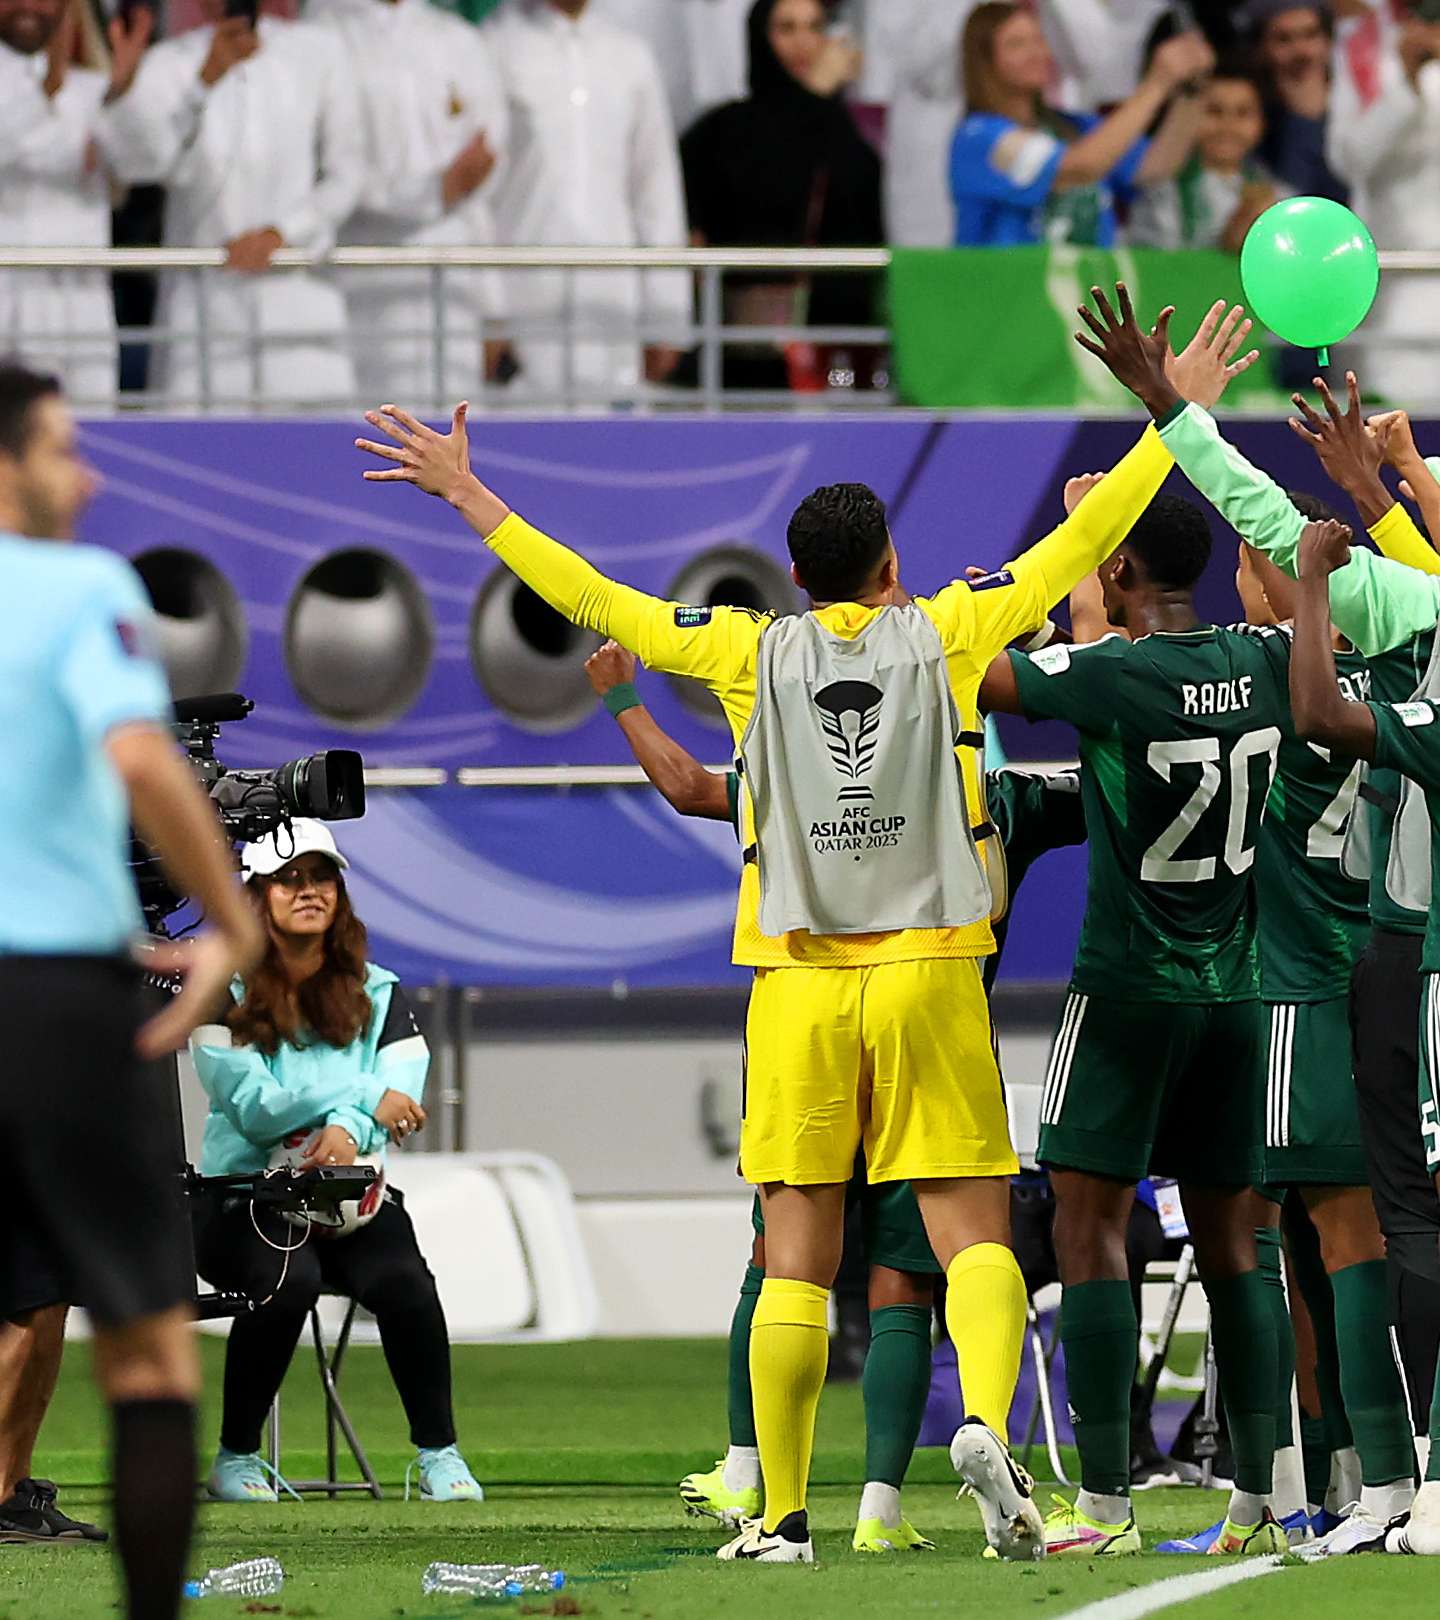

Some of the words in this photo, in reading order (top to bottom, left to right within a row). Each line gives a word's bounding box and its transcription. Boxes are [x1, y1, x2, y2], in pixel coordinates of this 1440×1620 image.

[1182, 675, 1252, 715] RADIF
[842, 806, 871, 819] AFC
[1140, 725, 1282, 882] 20
[809, 820, 867, 838] ASIAN
[869, 815, 906, 834] CUP
[814, 837, 862, 854] QATAR
[865, 832, 899, 849] 2023
